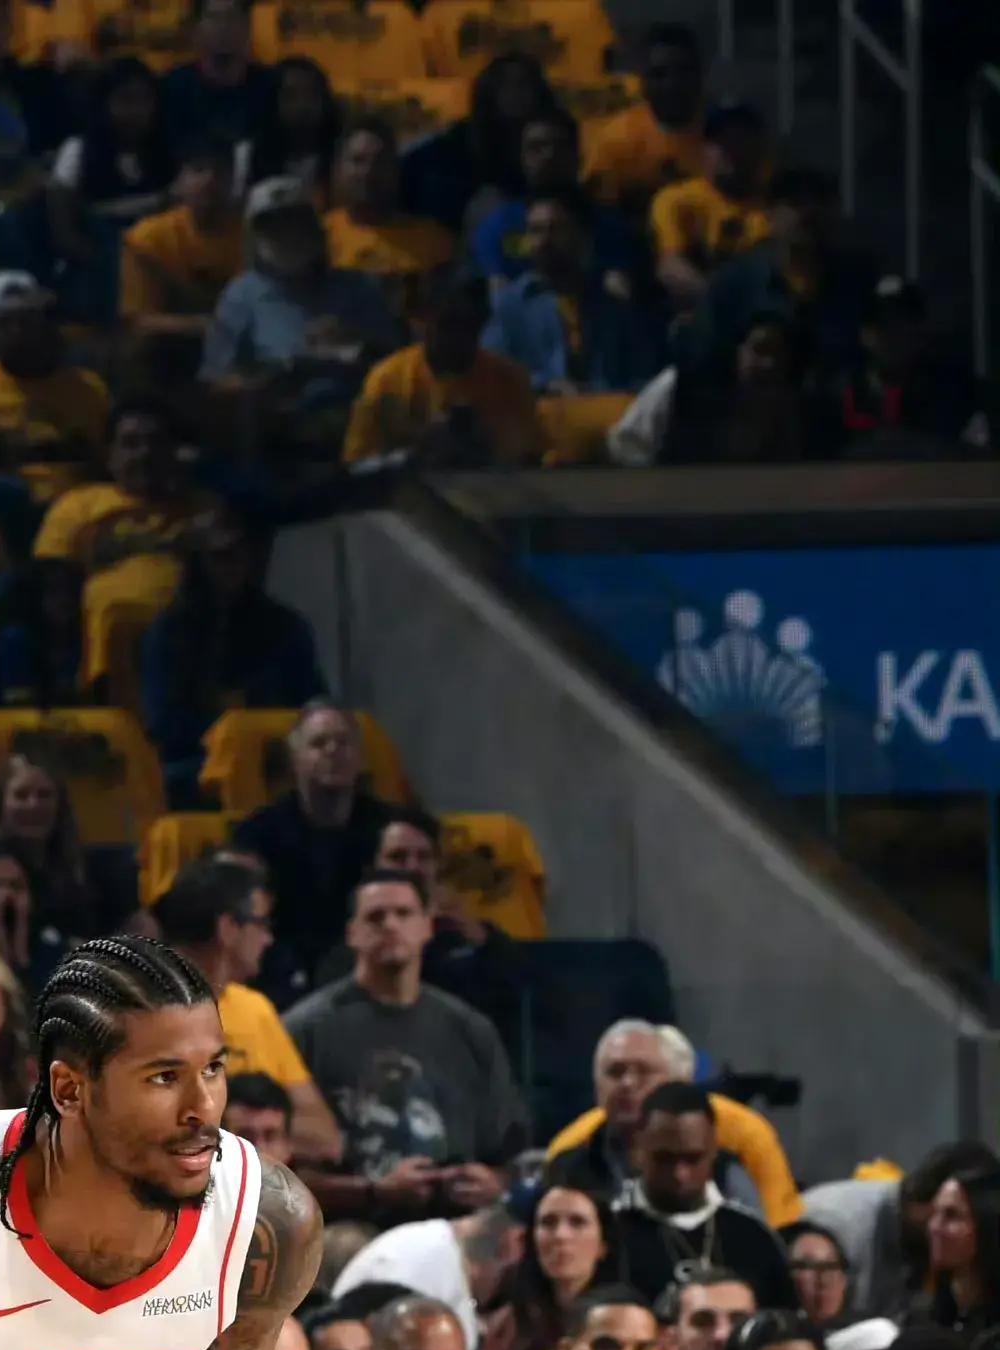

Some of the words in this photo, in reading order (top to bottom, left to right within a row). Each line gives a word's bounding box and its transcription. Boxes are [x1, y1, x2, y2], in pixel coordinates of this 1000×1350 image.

[876, 649, 1000, 742] KA
[143, 1299, 213, 1317] HERMANN
[145, 1290, 213, 1309] MEMORIAL
